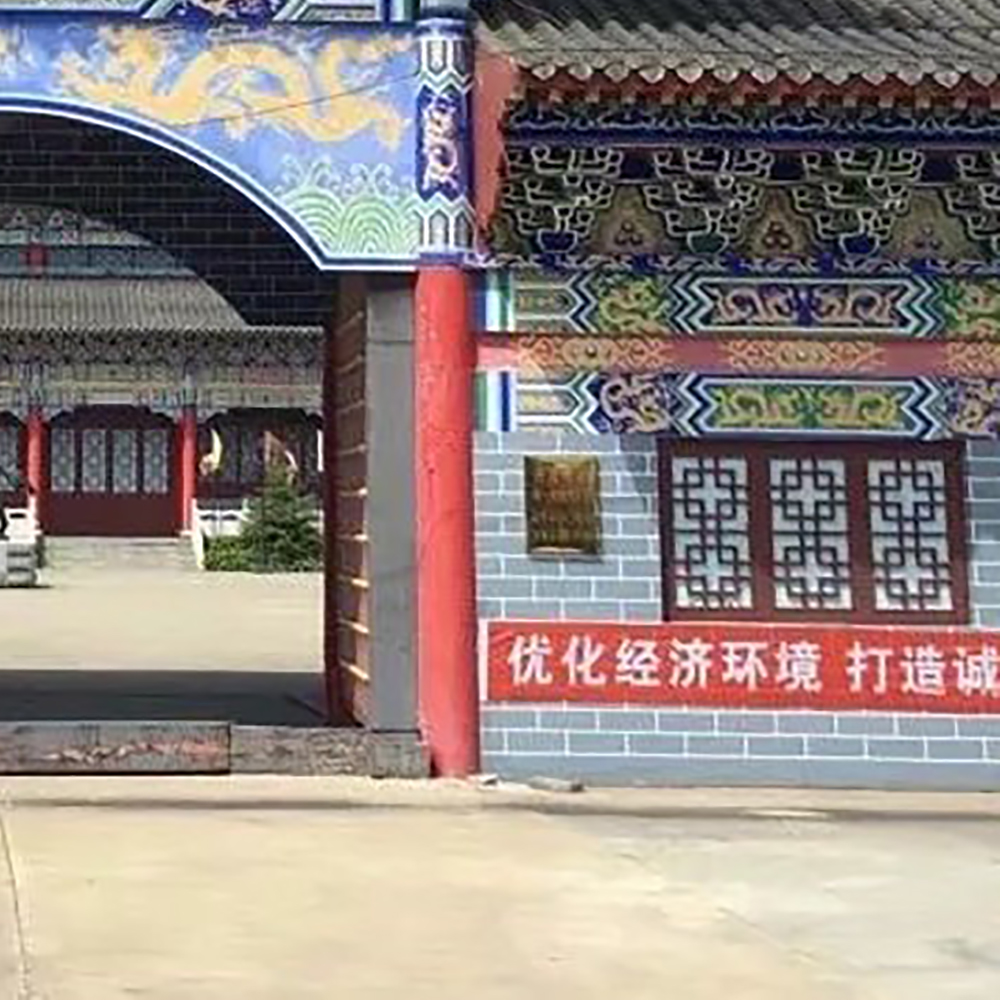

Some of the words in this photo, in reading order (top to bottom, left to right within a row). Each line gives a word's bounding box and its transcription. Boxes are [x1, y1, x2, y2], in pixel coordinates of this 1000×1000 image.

[507, 634, 823, 691] 优化经济环境
[845, 641, 1000, 697] 打造诚
